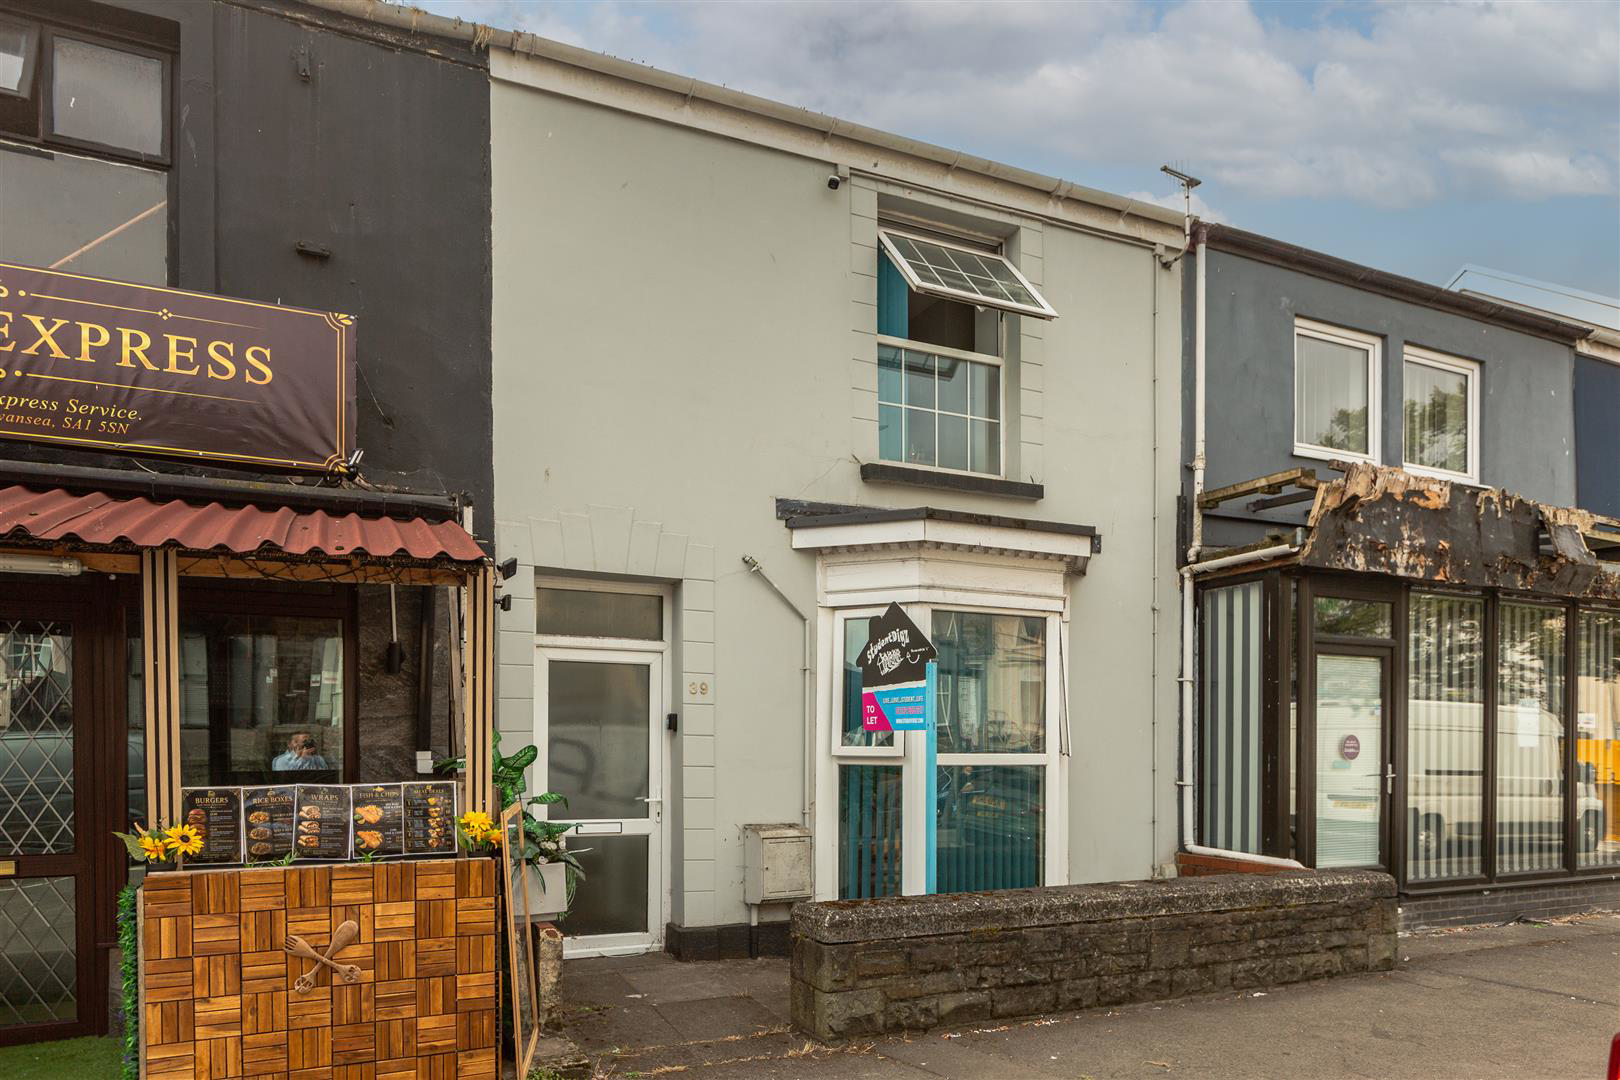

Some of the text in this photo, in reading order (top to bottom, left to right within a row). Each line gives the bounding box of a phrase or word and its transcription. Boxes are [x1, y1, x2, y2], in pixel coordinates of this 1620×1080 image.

[66, 398, 142, 421] Service.
[62, 416, 91, 431] SA1
[98, 420, 130, 435] 5SN
[688, 681, 709, 696] 39
[866, 705, 875, 714] TO
[866, 716, 878, 725] LET
[270, 795, 294, 803] BOXES
